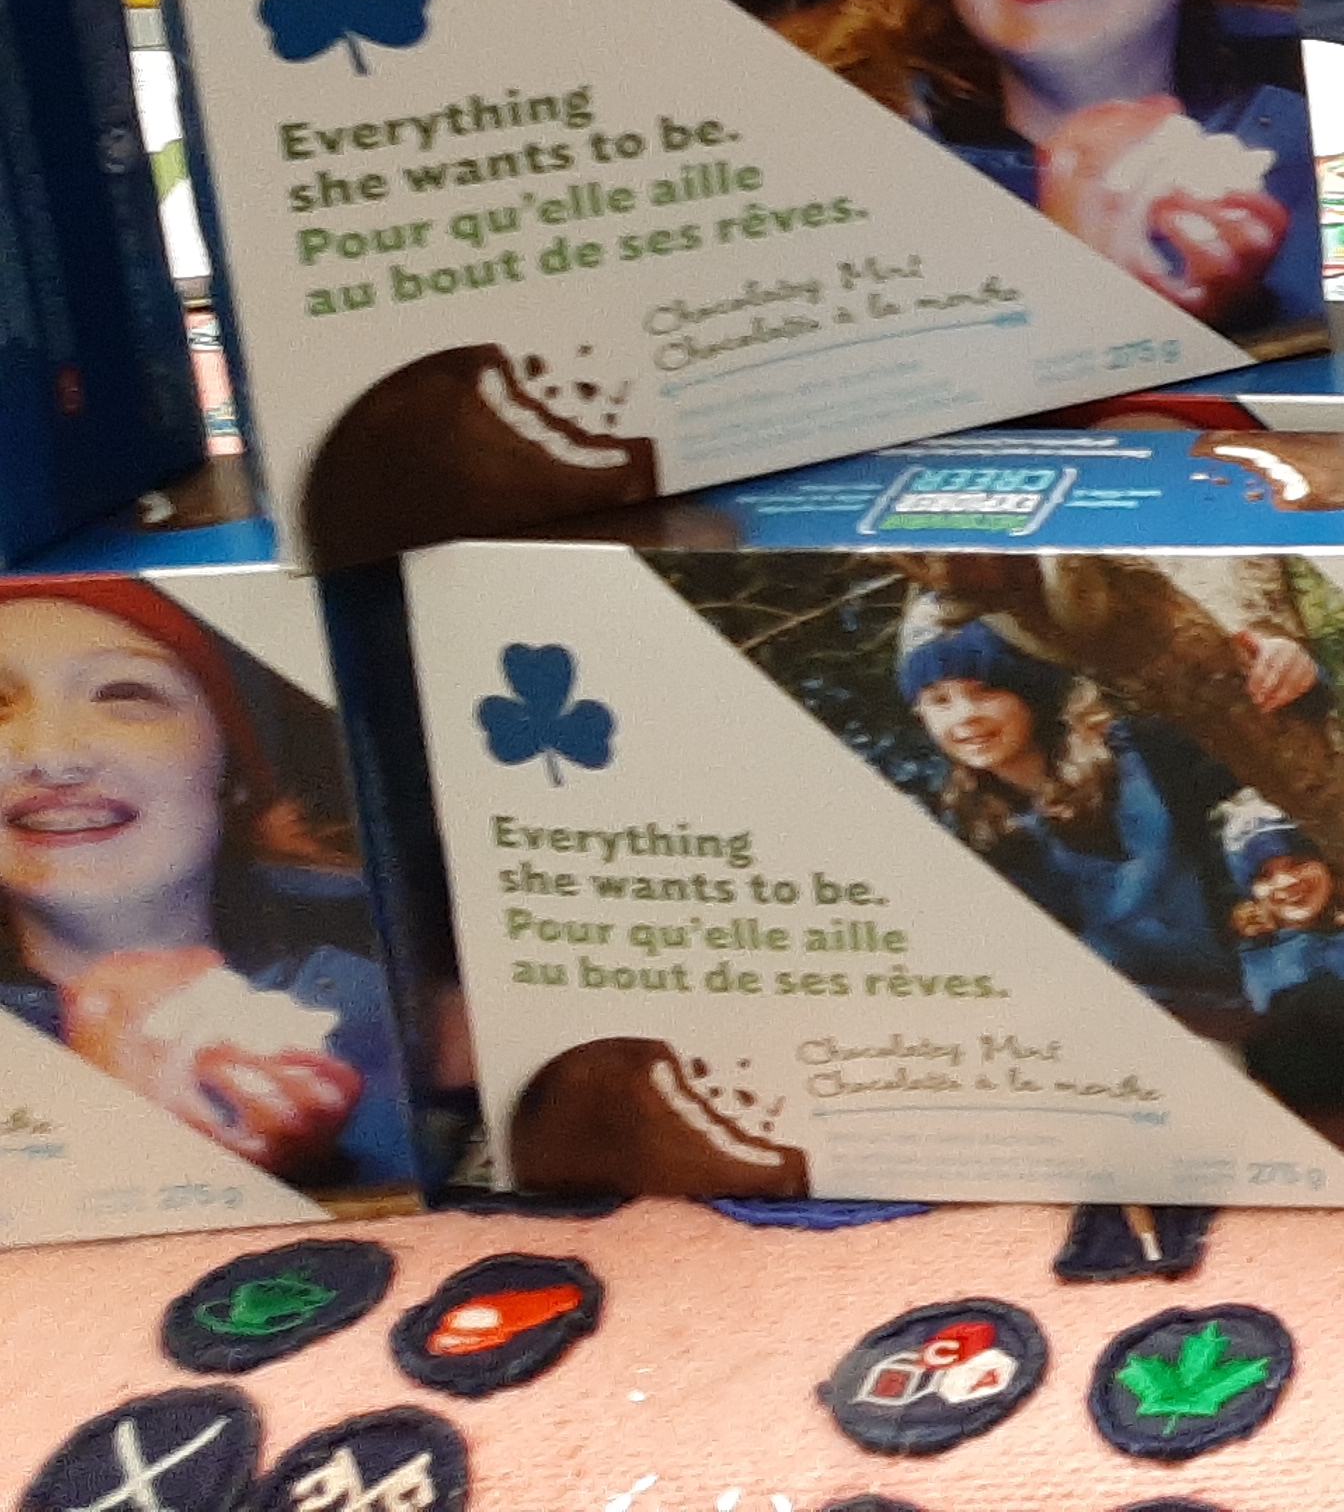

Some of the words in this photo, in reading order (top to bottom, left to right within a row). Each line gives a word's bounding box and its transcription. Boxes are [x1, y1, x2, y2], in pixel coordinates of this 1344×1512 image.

[278, 85, 594, 160] Everything
[289, 169, 388, 212] she
[403, 142, 575, 191] wants
[589, 130, 644, 164] to
[659, 115, 741, 153] be.
[297, 218, 432, 265] Pour
[449, 181, 636, 249] qu'elle
[649, 161, 763, 208] aille
[306, 283, 377, 317] au
[390, 249, 525, 303] bout
[538, 235, 604, 276] de
[618, 222, 703, 261] ses
[714, 195, 868, 244] rêves.
[491, 815, 754, 868] Everything
[499, 862, 578, 896] she
[591, 867, 736, 906] wants
[751, 870, 800, 906] to
[812, 871, 890, 908] be.
[505, 908, 611, 945] Pour
[627, 915, 788, 957] qu'elle
[804, 919, 908, 955] aille
[511, 959, 570, 988] au
[577, 953, 692, 993] bout
[703, 956, 765, 996] de
[774, 968, 850, 998] ses
[865, 962, 1010, 1001] rêves.
[920, 1339, 963, 1367] C
